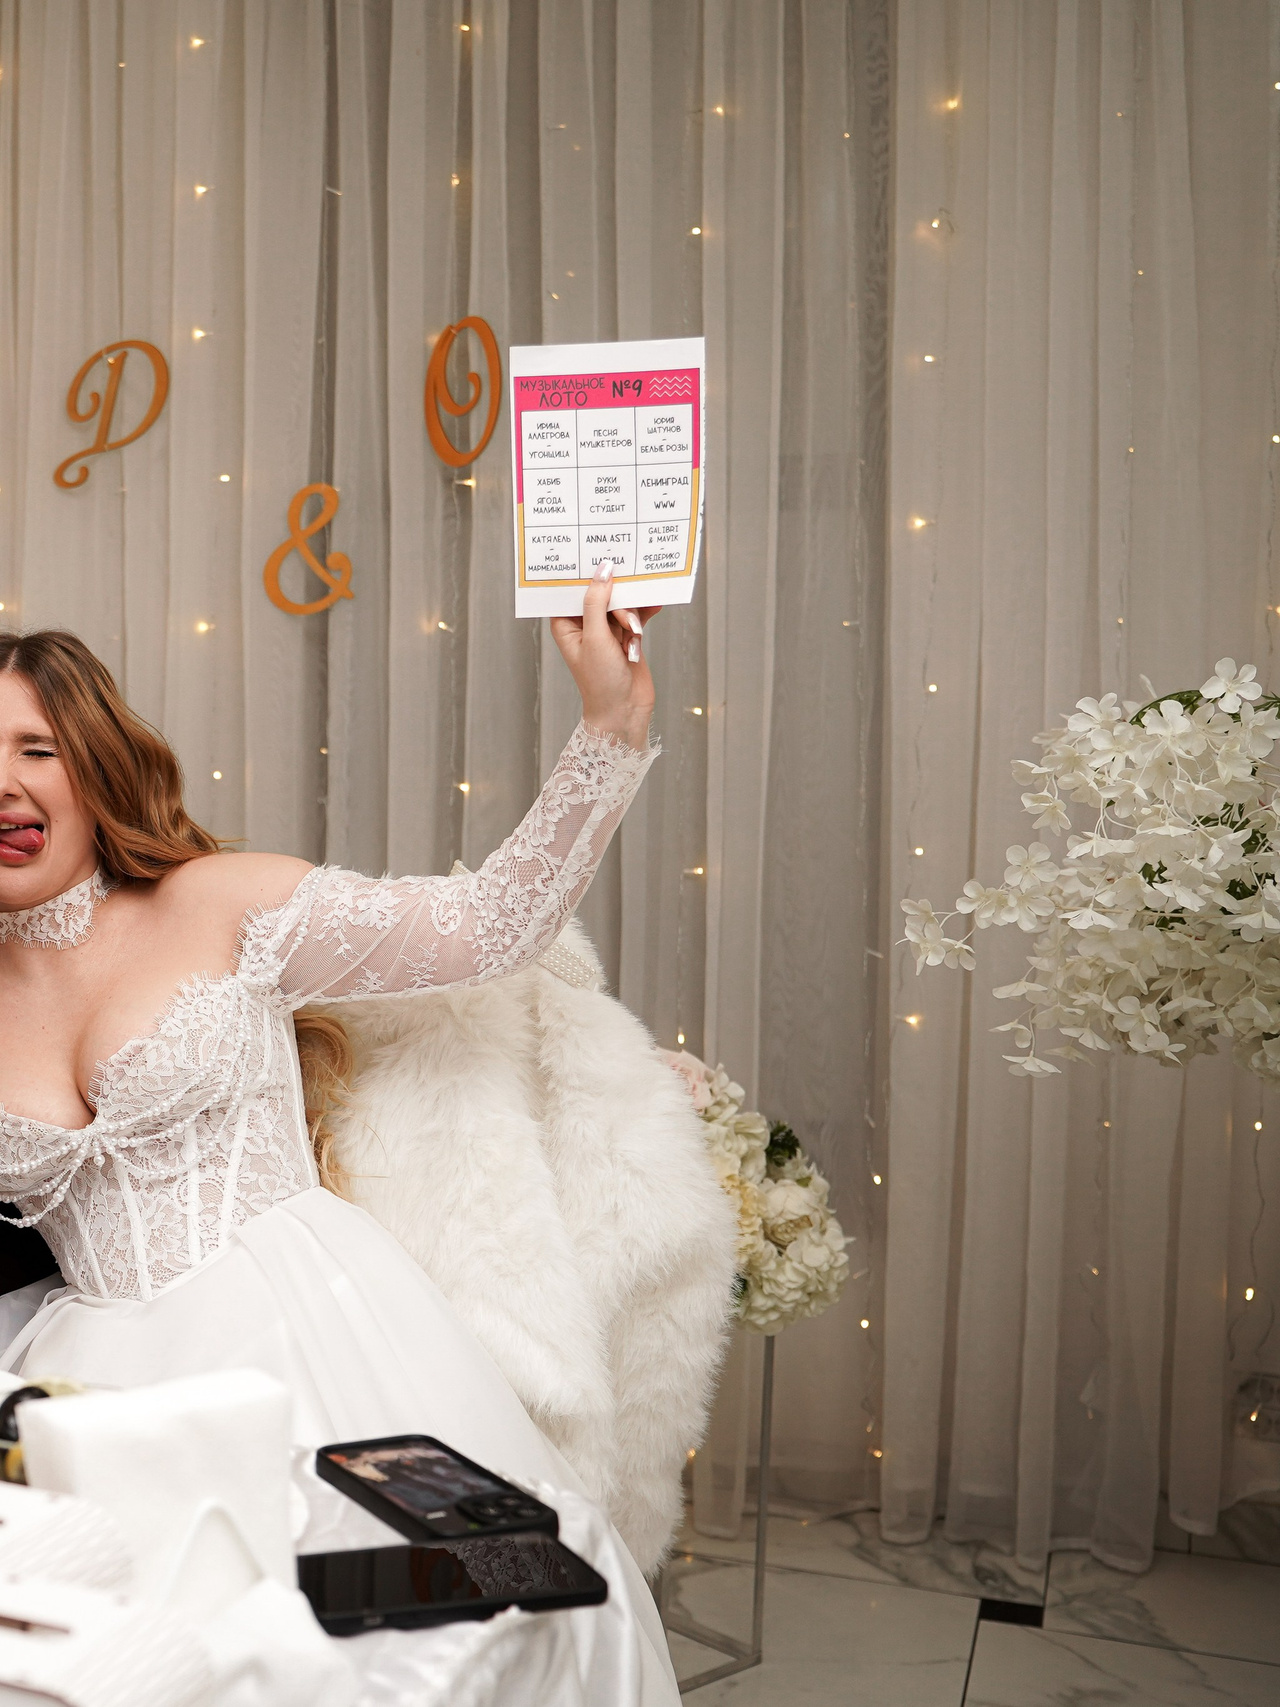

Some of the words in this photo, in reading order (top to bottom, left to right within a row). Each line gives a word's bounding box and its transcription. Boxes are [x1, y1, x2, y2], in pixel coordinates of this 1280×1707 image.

[520, 377, 605, 392] МУЗЫКАЛЬНОЕ
[539, 391, 588, 408] ЛОТО
[536, 422, 560, 430] ИРИНА
[646, 425, 682, 434] ШАТУНОВ
[528, 432, 570, 440] АЛЛЕГРОВА
[593, 429, 618, 437] ПЕСНЯ
[640, 445, 665, 453] БЕЛЫЕ
[666, 444, 688, 452] РОЗЫ
[529, 451, 570, 459] УГОНЩИЦА
[54, 340, 170, 489] D
[264, 483, 354, 615] &
[424, 316, 503, 468] O
[537, 478, 561, 486] ХАБИБ
[640, 476, 689, 487] ЛЕНИНГРАД
[594, 486, 621, 494] ВВЕРХ!
[537, 497, 562, 505] ЯГОДА
[653, 500, 676, 509] WWW
[589, 504, 625, 513] СТУДЕНТ
[648, 525, 679, 534] GALIBRI
[531, 536, 552, 544] КАТЯ
[552, 535, 572, 543] ЛЕЛЬ
[585, 534, 608, 543] ANNA
[609, 533, 631, 542] ASTI
[656, 534, 679, 542] MAVIK
[643, 552, 681, 563] ФЕДЕРИКО
[644, 562, 677, 571] ФЕЛЛИНИ
